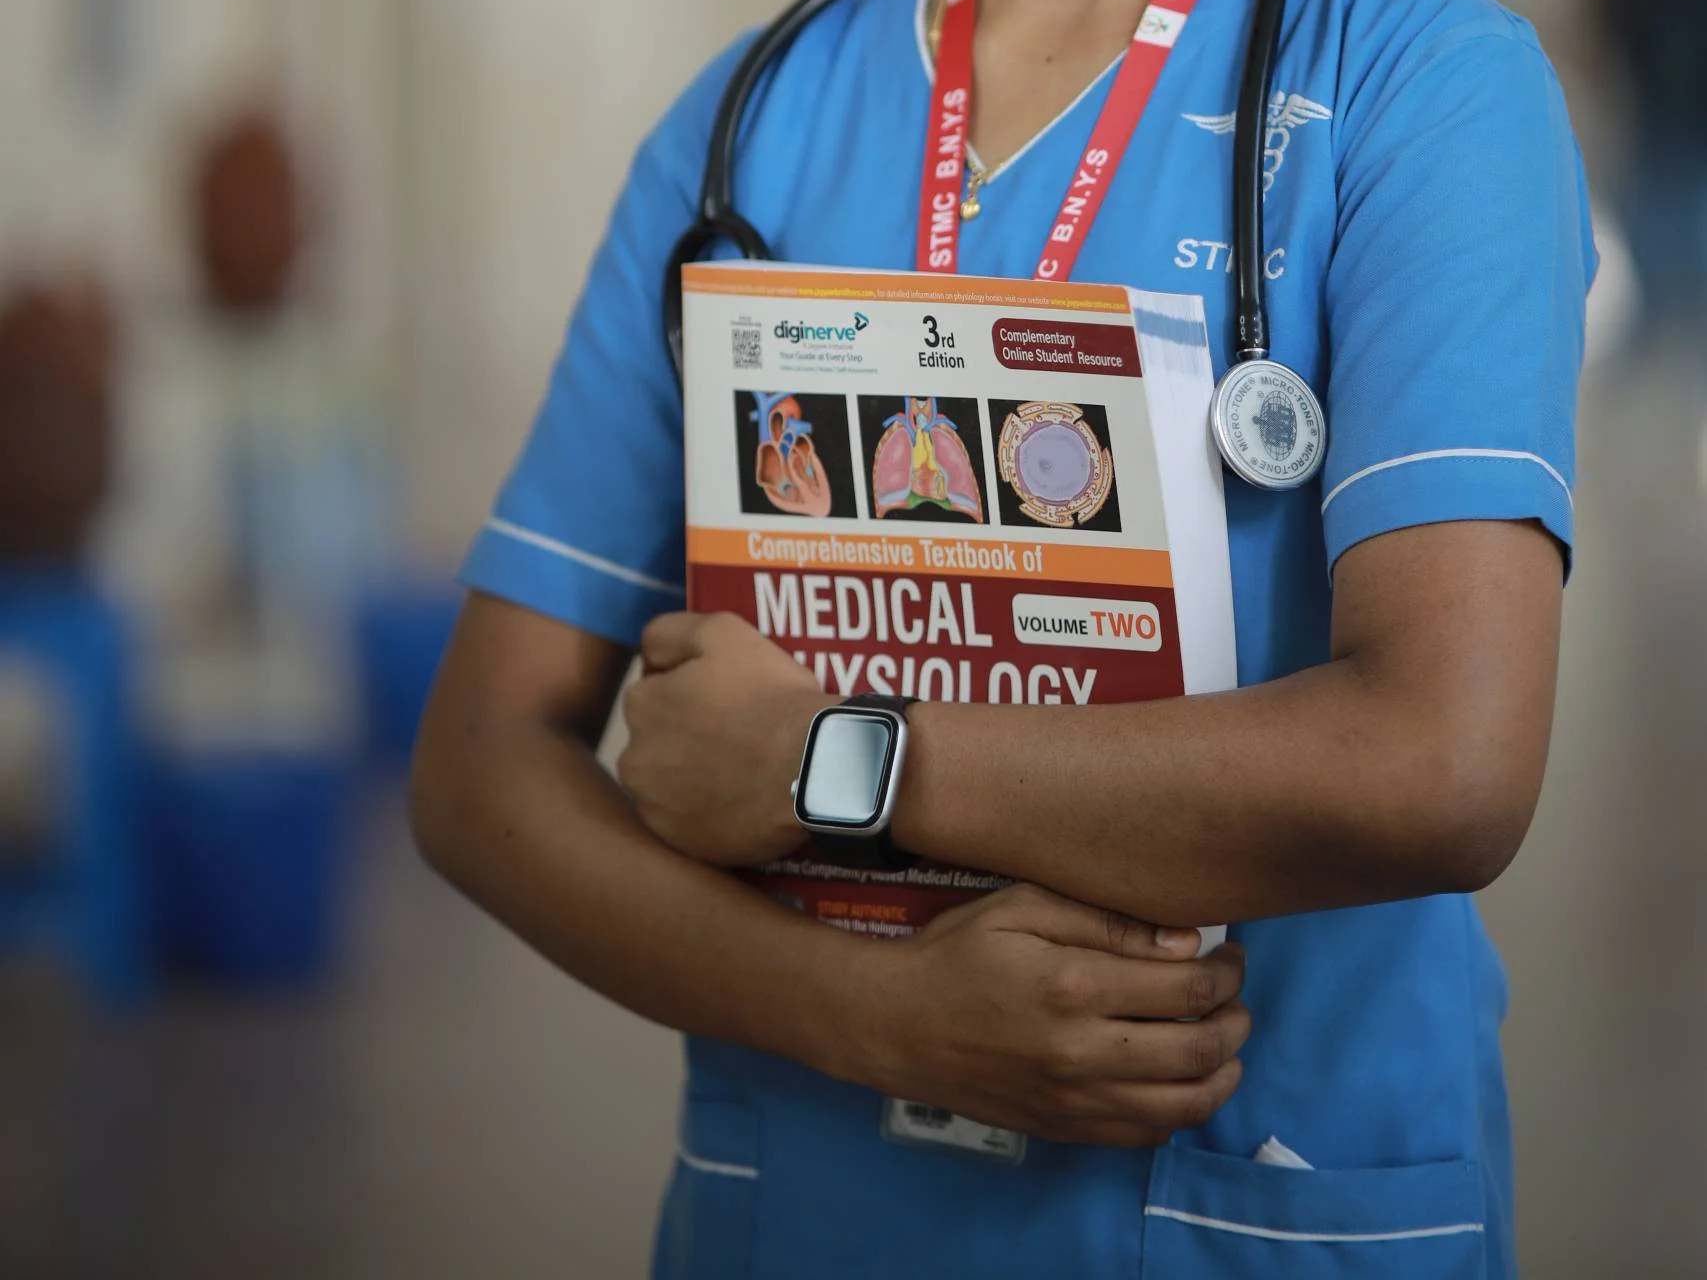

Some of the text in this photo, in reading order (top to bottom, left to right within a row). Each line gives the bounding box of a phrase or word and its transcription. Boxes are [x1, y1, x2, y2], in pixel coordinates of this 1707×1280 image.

[929, 88, 967, 268] STMC B.N.Y.S
[1051, 148, 1108, 243] B.N.Y.S
[953, 292, 985, 304] physiology
[774, 320, 857, 344] diginerve
[922, 315, 955, 349] 3rd
[1000, 327, 1075, 349] Complementary
[846, 353, 863, 363] Step
[918, 351, 965, 369] Edition
[1002, 347, 1123, 367] Online Student Resource
[747, 530, 1043, 573] Comprehensive Textbook of
[753, 572, 993, 648] MEDICAL
[1018, 610, 1156, 640] VOLUME TWO
[794, 650, 1098, 705] YSIOLOGY
[906, 867, 951, 886] Medical
